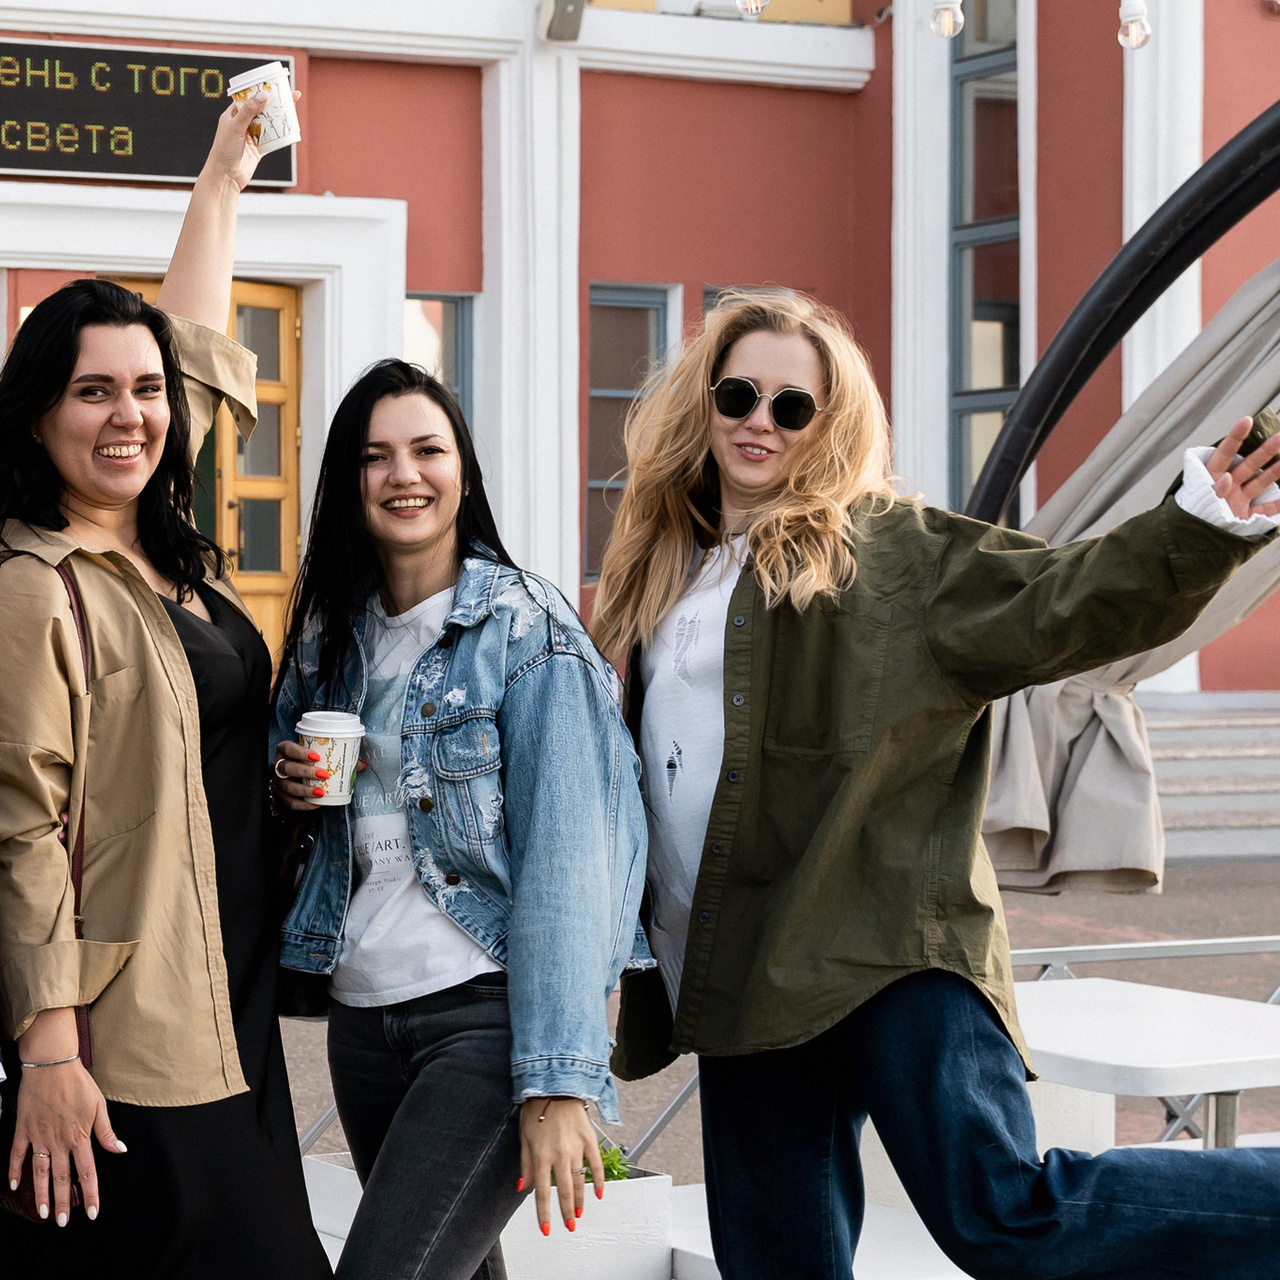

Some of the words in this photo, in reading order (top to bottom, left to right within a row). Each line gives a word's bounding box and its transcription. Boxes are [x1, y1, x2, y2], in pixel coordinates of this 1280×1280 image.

[91, 61, 111, 92] с
[126, 63, 224, 98] того
[0, 119, 134, 155] света
